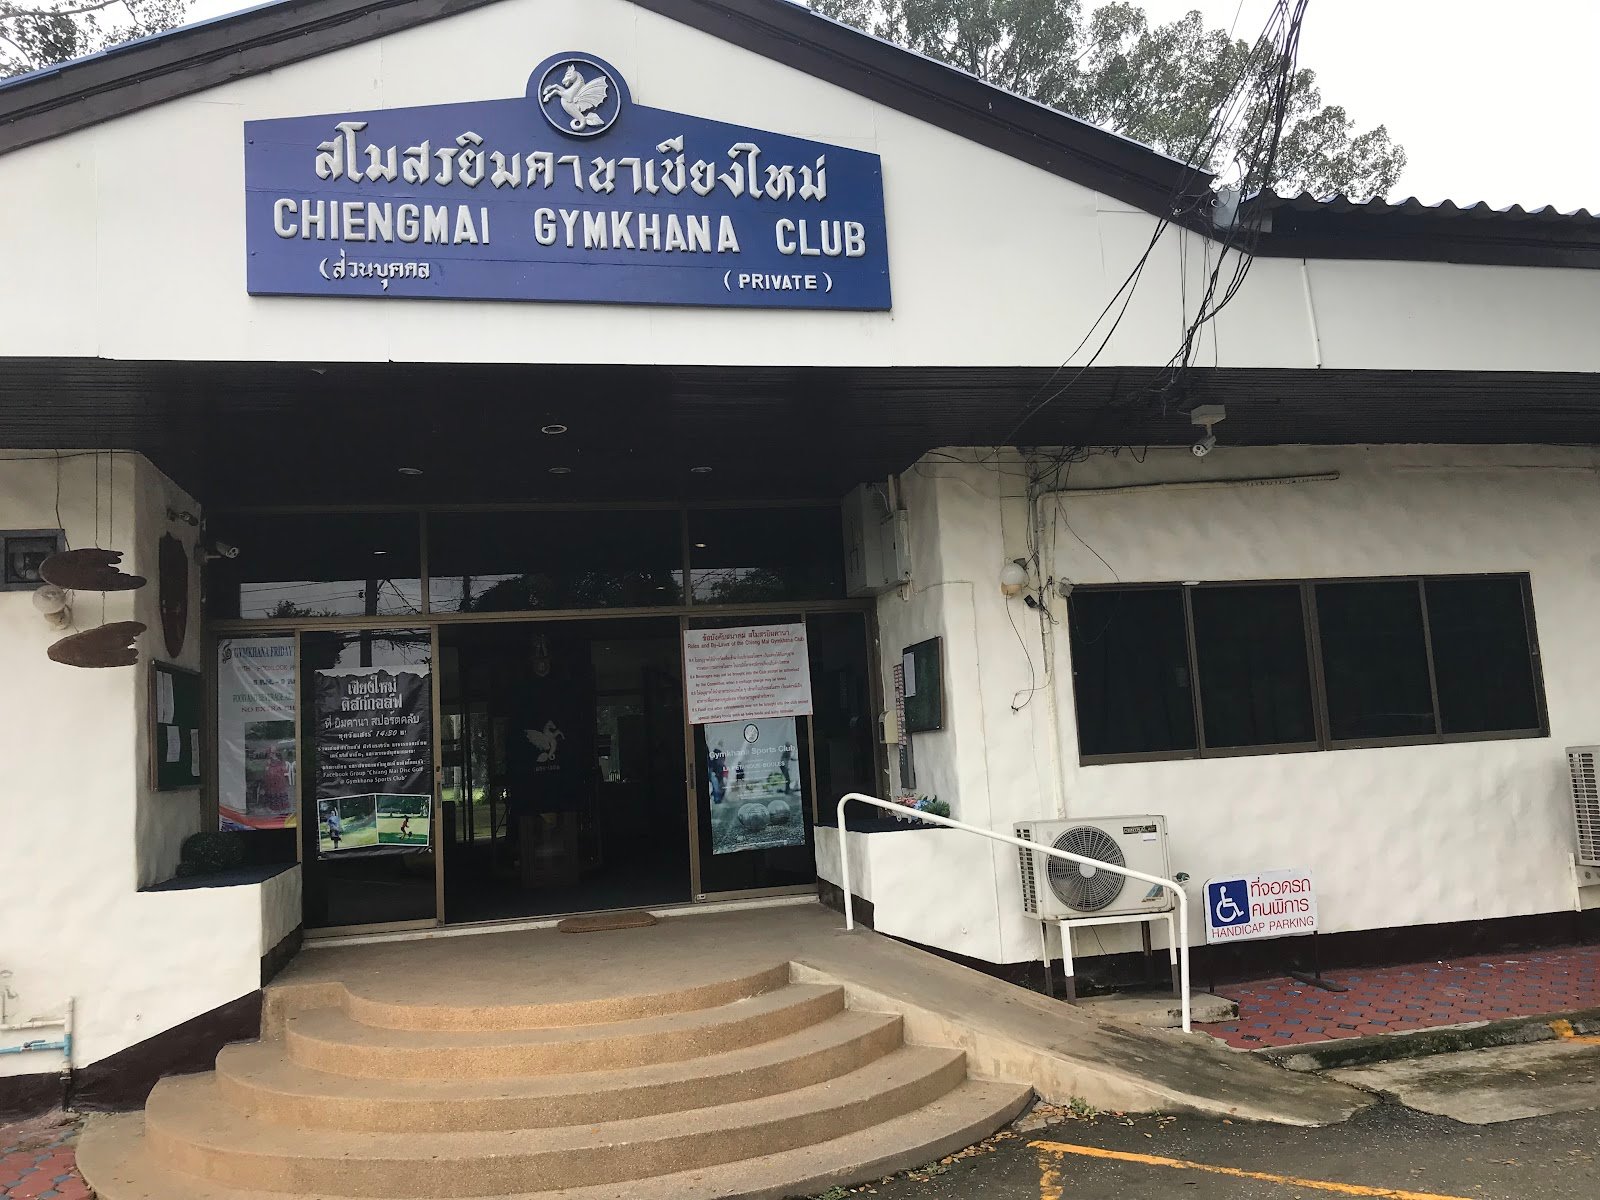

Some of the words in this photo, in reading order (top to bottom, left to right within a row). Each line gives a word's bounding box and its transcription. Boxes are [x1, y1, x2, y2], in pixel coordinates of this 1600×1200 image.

[273, 198, 490, 245] CHIENGMAI
[534, 207, 741, 253] GYMKHANA
[775, 218, 866, 258] CLUB
[270, 645, 292, 657] FRIDAY
[347, 674, 397, 695] เชียงใหม่
[341, 693, 403, 711] ดิสก์กอล์ฟ
[324, 714, 332, 729] ที่
[334, 717, 369, 729] ยิมคานา
[371, 710, 420, 726] สปอร์ตคลับ
[709, 750, 749, 760] Gymkhana
[751, 747, 776, 755] Sports
[777, 744, 796, 753] Club
[323, 770, 349, 778] Facebook
[345, 777, 374, 785] Gymkhana
[374, 775, 392, 783] Sports
[1250, 876, 1311, 897] ที่จอดรถ
[1252, 898, 1310, 917] คนพิการ
[1211, 922, 1265, 939] HANDICAP
[1269, 915, 1314, 931] PARKING
